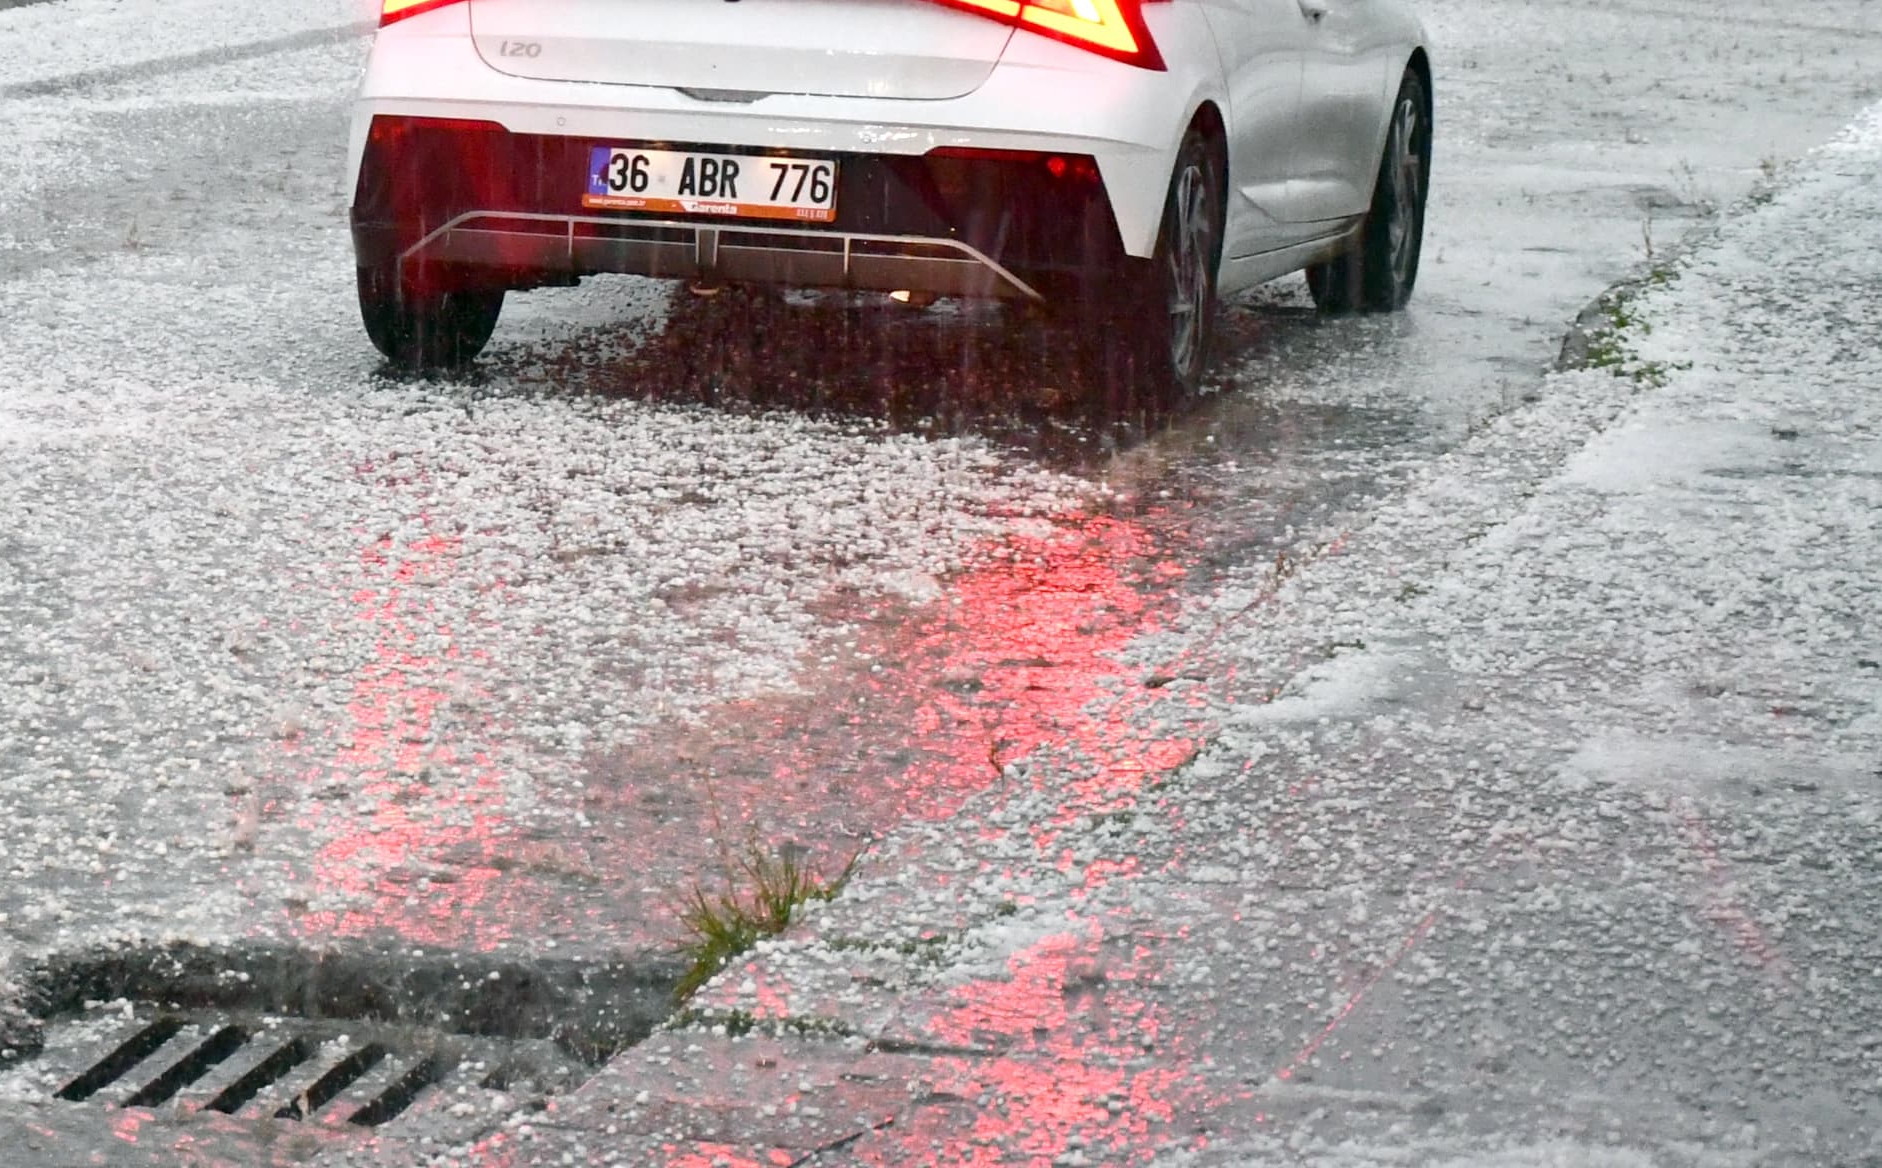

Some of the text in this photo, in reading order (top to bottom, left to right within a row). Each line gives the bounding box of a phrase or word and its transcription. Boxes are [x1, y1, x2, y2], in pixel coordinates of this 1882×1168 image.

[609, 152, 650, 193] 36
[677, 157, 739, 199] ABR
[769, 163, 831, 203] 776
